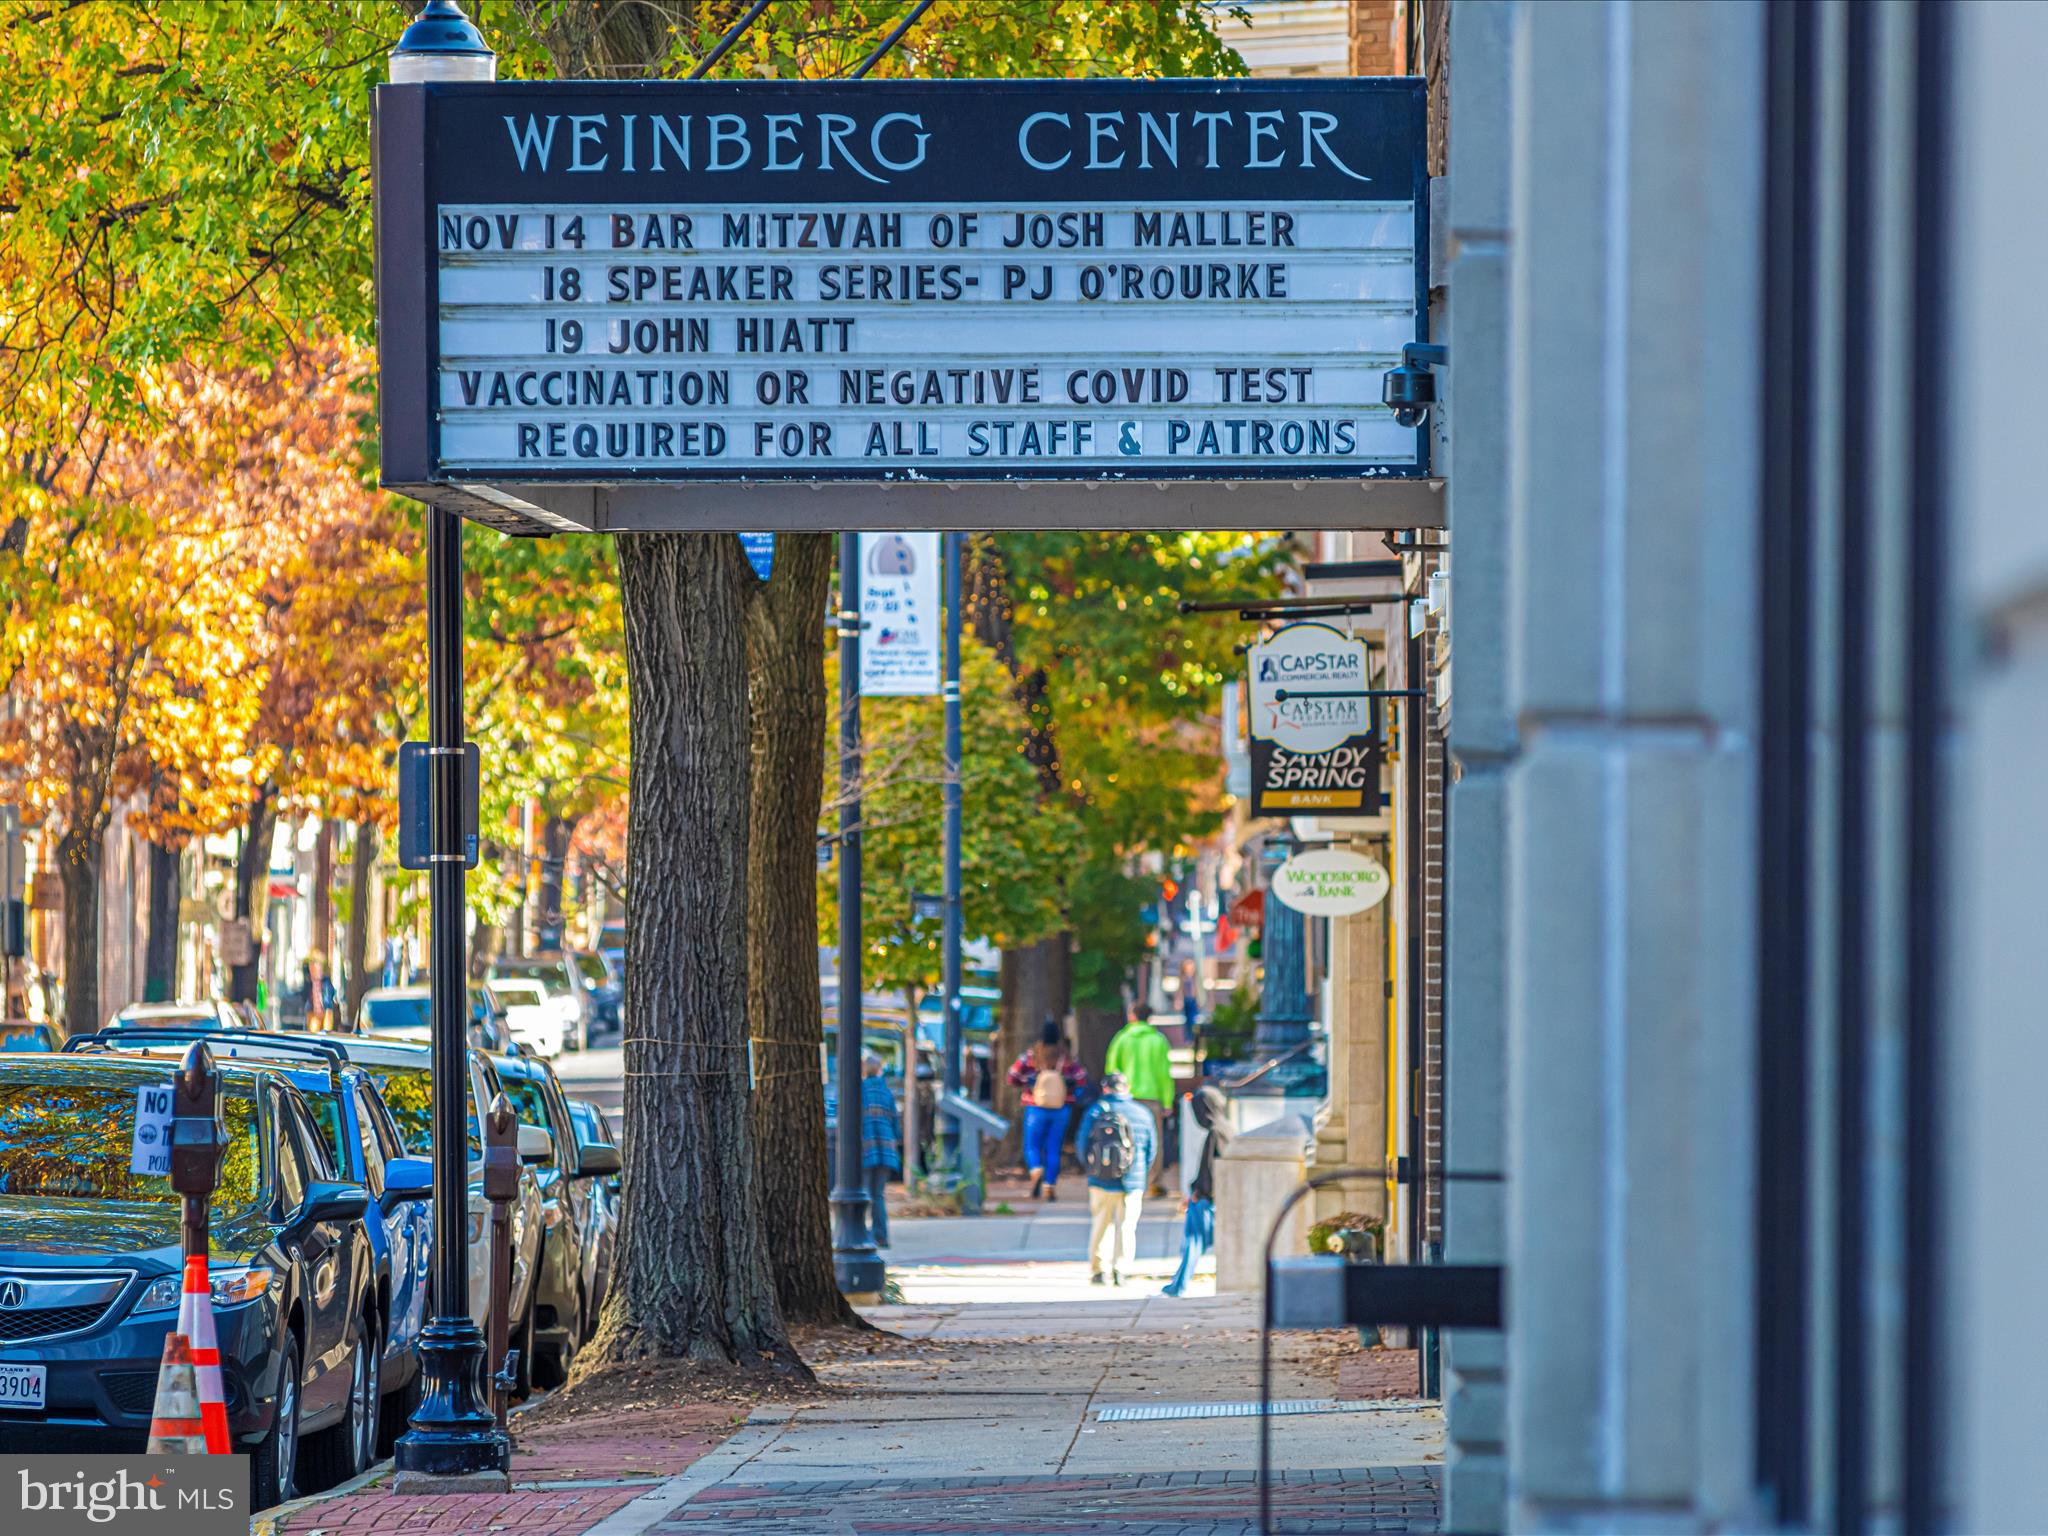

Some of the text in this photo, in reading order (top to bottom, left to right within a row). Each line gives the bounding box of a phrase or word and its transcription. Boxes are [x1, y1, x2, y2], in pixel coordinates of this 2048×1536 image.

[503, 109, 1372, 184] WEINBERG CENTER
[441, 211, 1295, 250] NOV 14 BAR MITZVAH OF JOSH MALLER
[544, 264, 1287, 302] 18 SPEAKER SERIES- PJ O'ROURKE
[546, 318, 855, 354] 19 JOHN HIATT
[458, 368, 1312, 406] VACCINATION OR NEGATIVE COVID TEST
[518, 420, 1356, 458] REQUIRED FOR ALL STAFF & PATRONS
[1280, 653, 1359, 672] CAPSTAR
[1281, 671, 1359, 682] COMMERCIAL REALTY
[1280, 700, 1358, 716] CAPSTAR
[1268, 746, 1370, 768] SANDY
[1266, 767, 1366, 788] SPRING
[1290, 794, 1333, 805] BANK
[1318, 885, 1355, 898] BANK
[144, 1091, 168, 1114] NO
[0, 1375, 41, 1398] 3904
